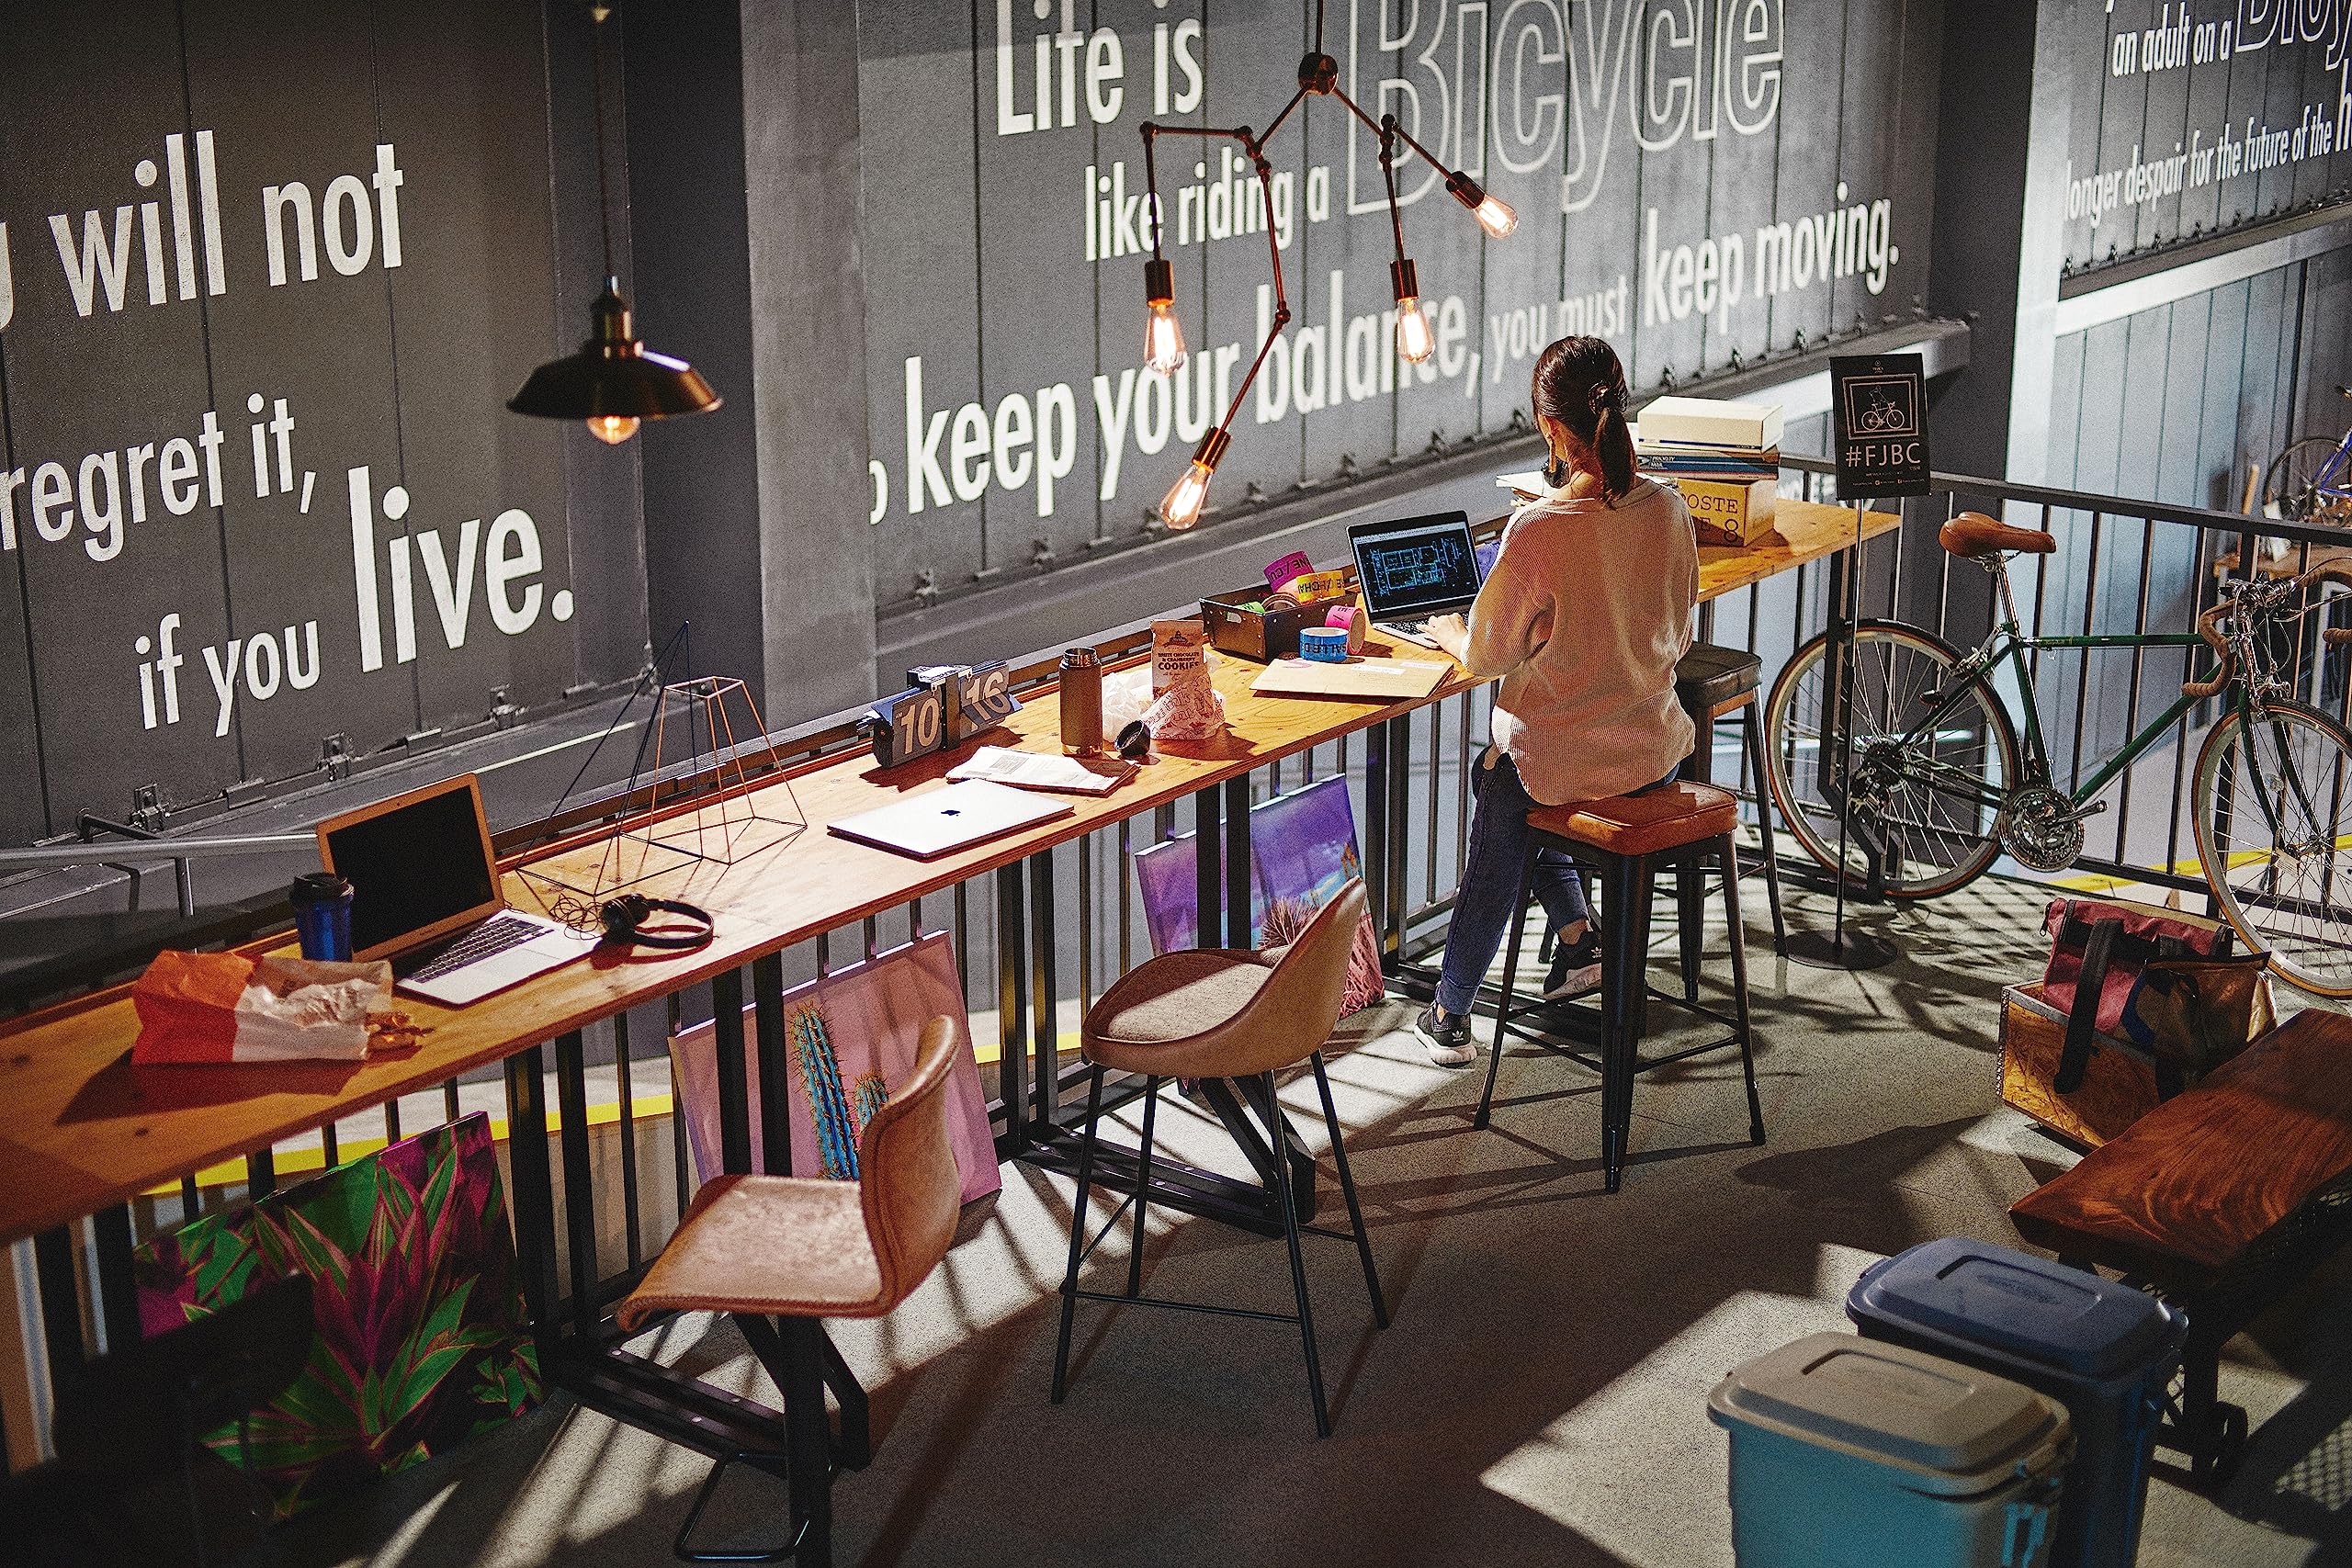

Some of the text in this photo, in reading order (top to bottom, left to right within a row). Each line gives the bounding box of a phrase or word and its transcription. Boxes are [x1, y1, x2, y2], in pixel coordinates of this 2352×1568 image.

[995, 0, 1204, 136] Life is
[2112, 31, 2137, 77] an
[2141, 2, 2190, 73] adult
[2192, 22, 2216, 66] on
[2218, 20, 2233, 62] a
[1084, 0, 1784, 262] like riding a Bicycle
[2066, 160, 2122, 229] longer
[2123, 143, 2187, 212] despair
[2188, 130, 2215, 188] for
[2215, 123, 2242, 182] the
[2243, 117, 2290, 175] future
[2290, 105, 2311, 164] of
[2308, 103, 2333, 159] the
[49, 130, 227, 318] will
[263, 144, 404, 288] not
[904, 355, 1077, 518] keep
[1093, 342, 1240, 502] your
[1490, 303, 1549, 382] you
[1559, 275, 1629, 343] must
[1644, 209, 1742, 335] keep
[1756, 183, 1901, 294] moving.
[0, 392, 318, 562] regret it,
[1680, 492, 1738, 514] OSTE
[1845, 442, 1922, 468] #FJBC
[134, 466, 574, 738] if you live.
[900, 697, 940, 754] 10
